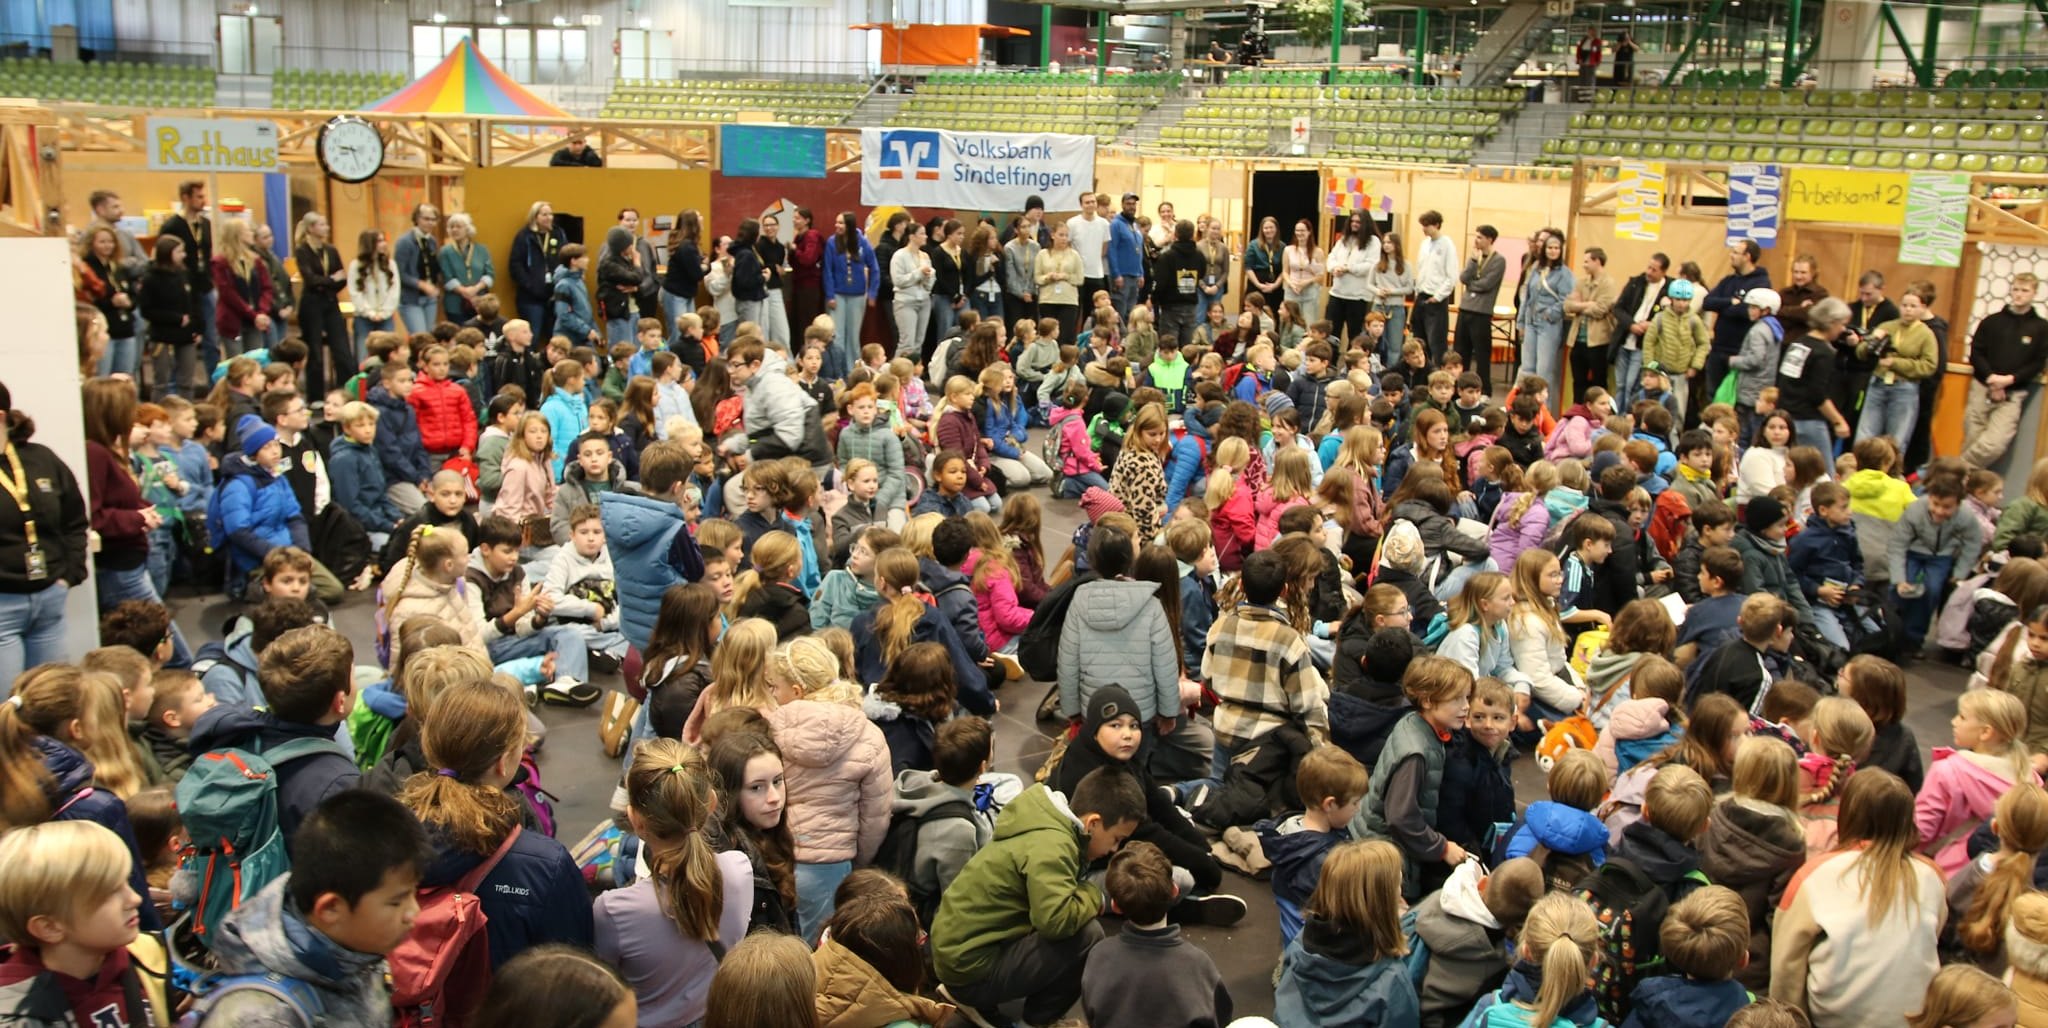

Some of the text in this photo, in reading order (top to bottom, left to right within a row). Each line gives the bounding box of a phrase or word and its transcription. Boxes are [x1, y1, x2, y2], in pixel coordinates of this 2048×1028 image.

[156, 126, 277, 168] Rathaus
[736, 130, 818, 172] BANK
[954, 137, 1052, 160] Volksbank
[953, 163, 1072, 191] Sindelfingen
[1788, 179, 1882, 206] Arbeitsamt
[1886, 184, 1904, 205] 2
